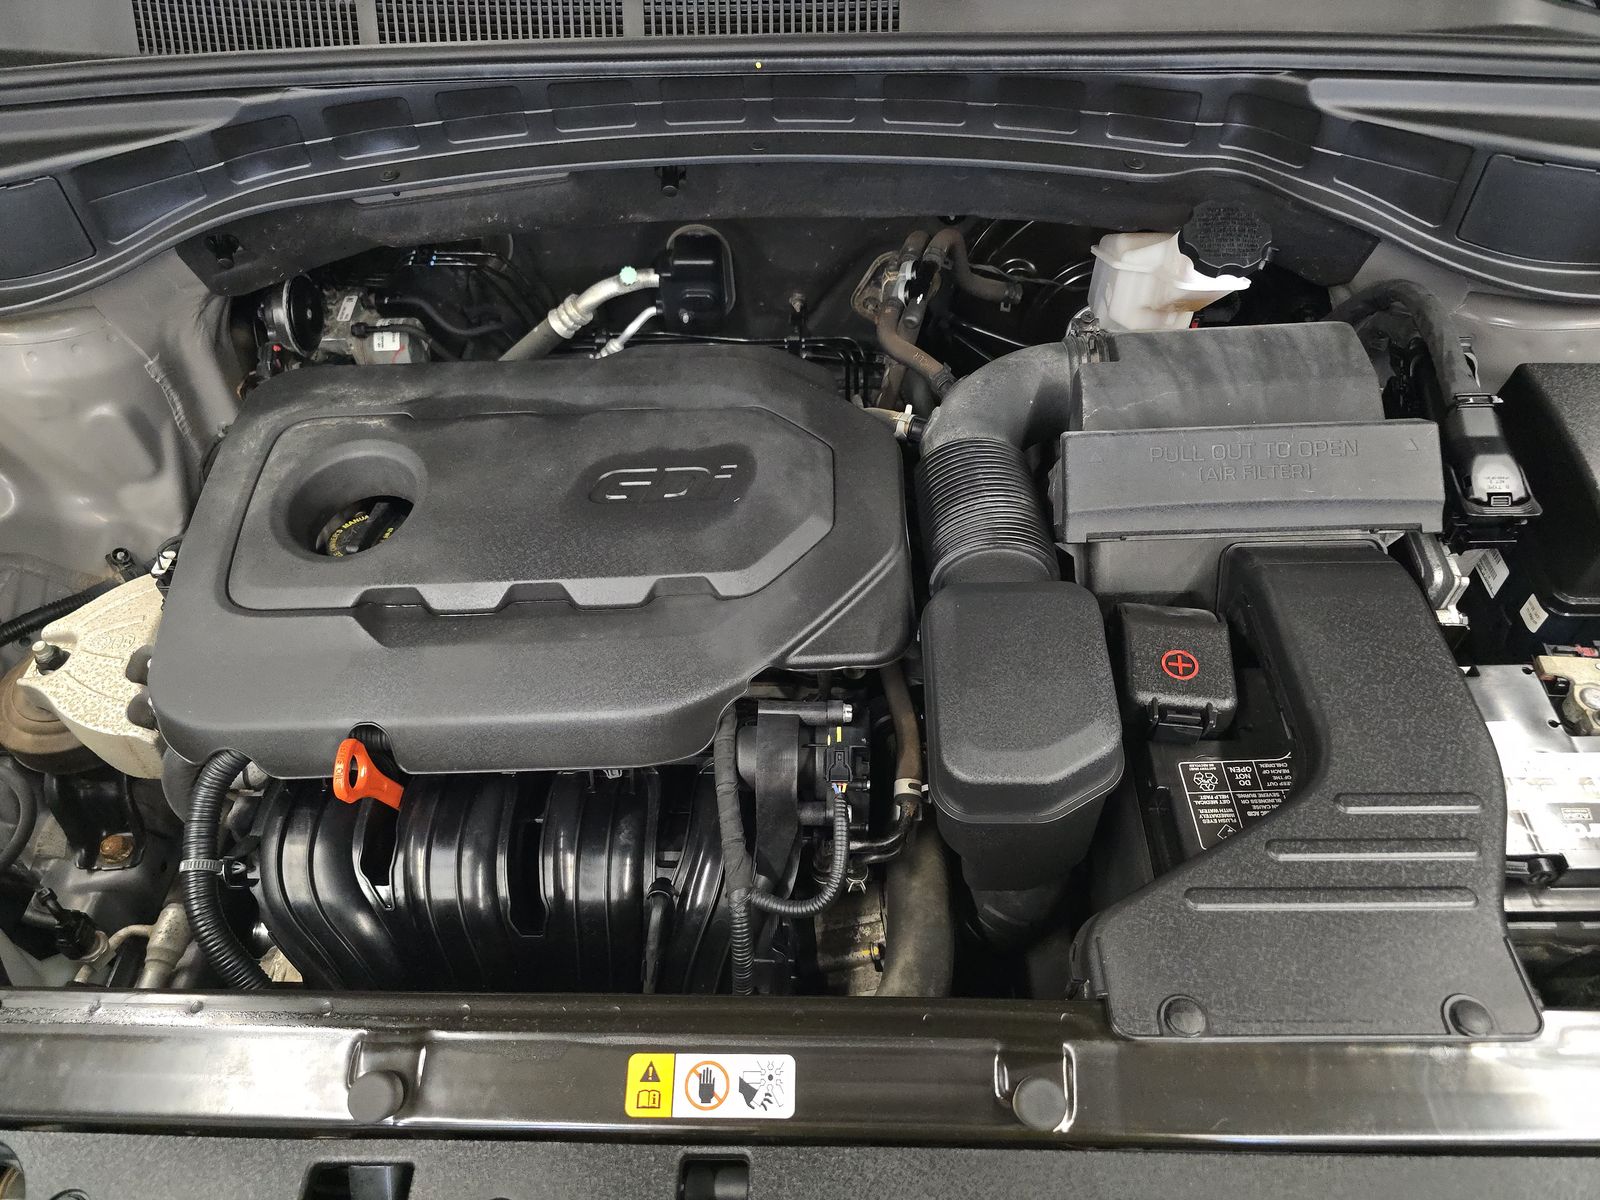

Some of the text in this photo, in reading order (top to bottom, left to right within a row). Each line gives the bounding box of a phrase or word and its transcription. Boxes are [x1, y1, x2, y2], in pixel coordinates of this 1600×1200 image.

[1150, 439, 1359, 462] PULL OUT TO OPEN
[342, 514, 370, 529] MANUA
